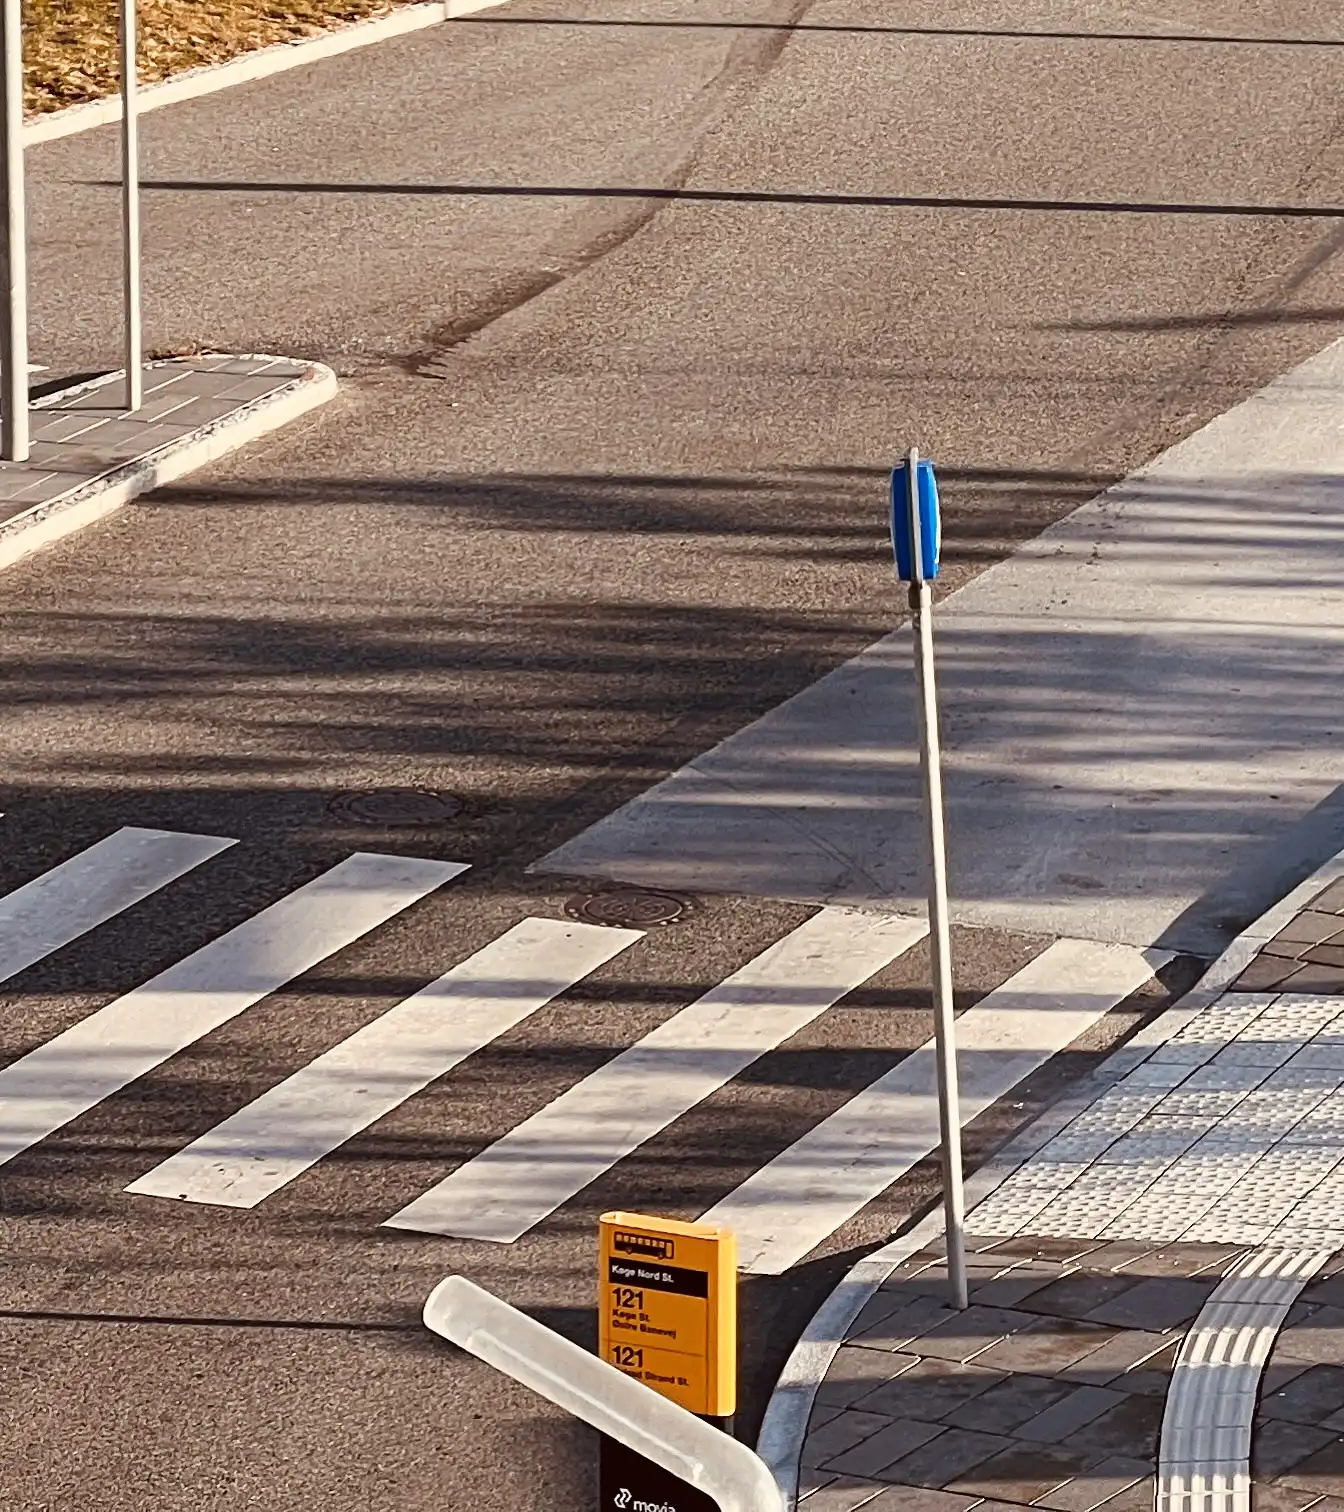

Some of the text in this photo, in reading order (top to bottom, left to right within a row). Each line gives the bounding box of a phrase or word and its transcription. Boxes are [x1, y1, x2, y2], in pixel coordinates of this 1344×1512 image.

[637, 1268, 660, 1281] Nord
[612, 1287, 643, 1310] 121
[612, 1345, 643, 1368] 121
